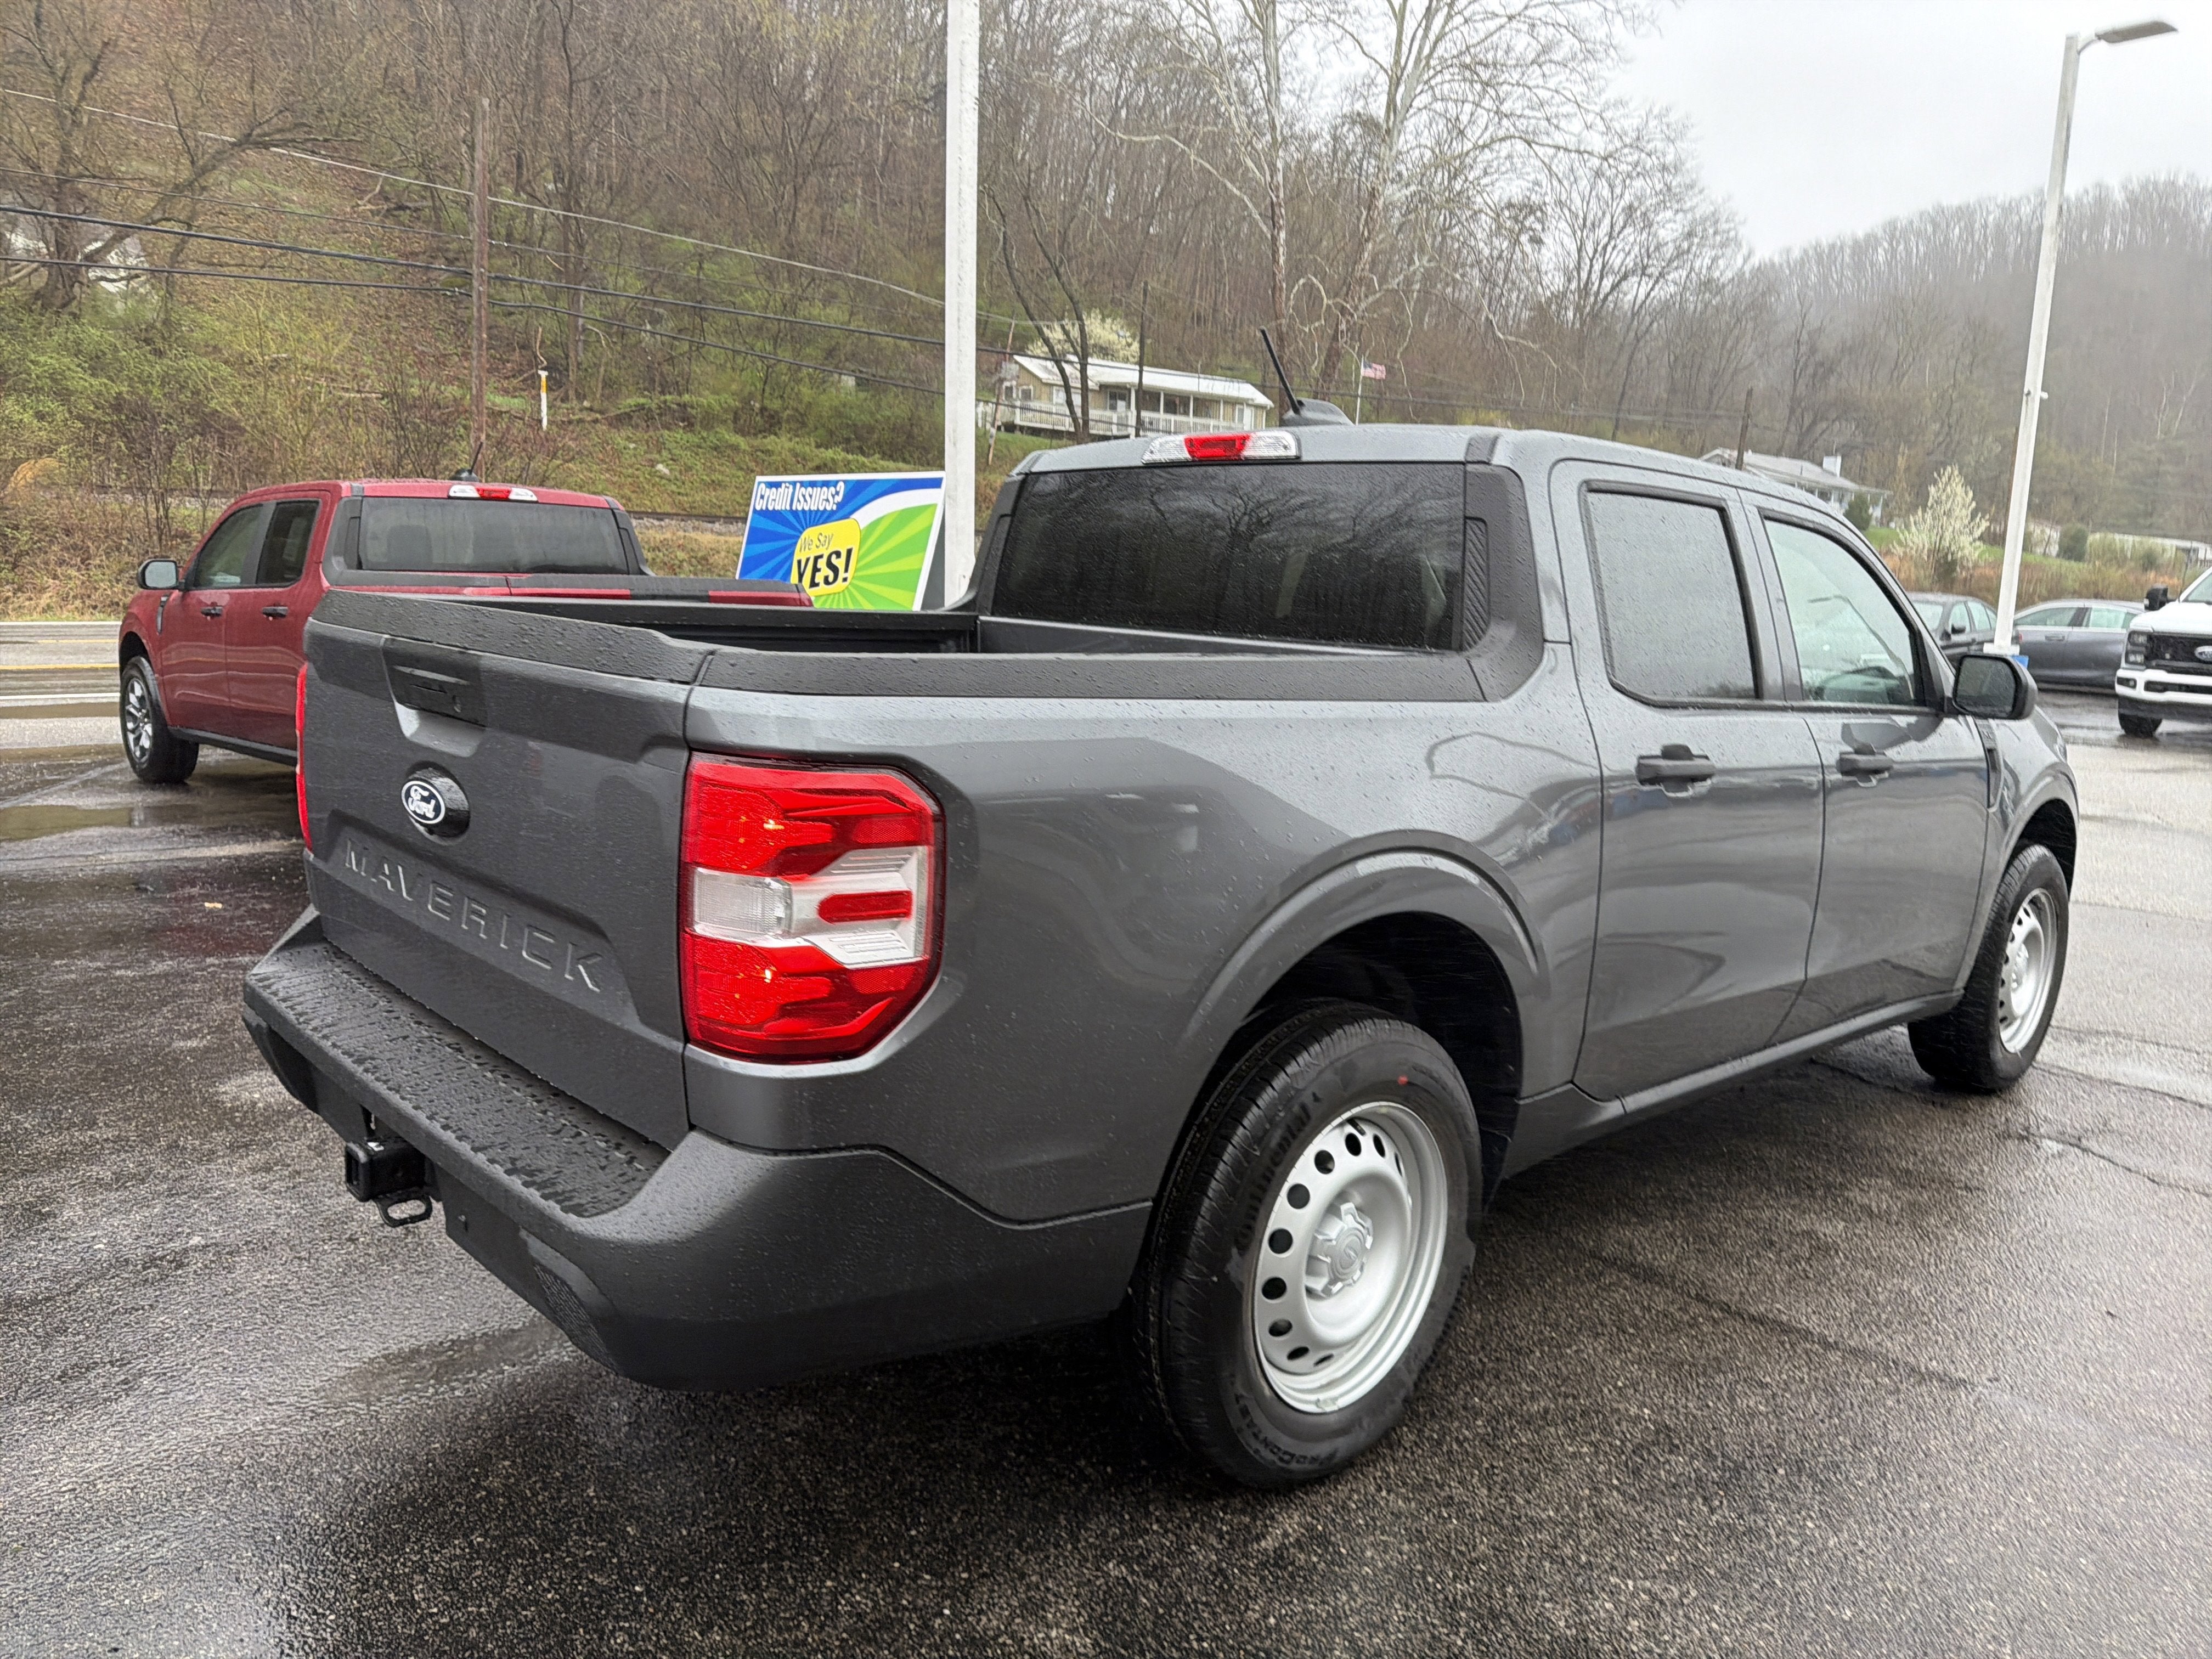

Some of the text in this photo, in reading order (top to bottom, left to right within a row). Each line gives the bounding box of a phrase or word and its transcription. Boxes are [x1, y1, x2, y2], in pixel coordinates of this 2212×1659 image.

[755, 481, 845, 511] Credit Issues?
[799, 532, 833, 553] We Say
[797, 547, 854, 589] YES!
[345, 838, 603, 993] MAVERICK
